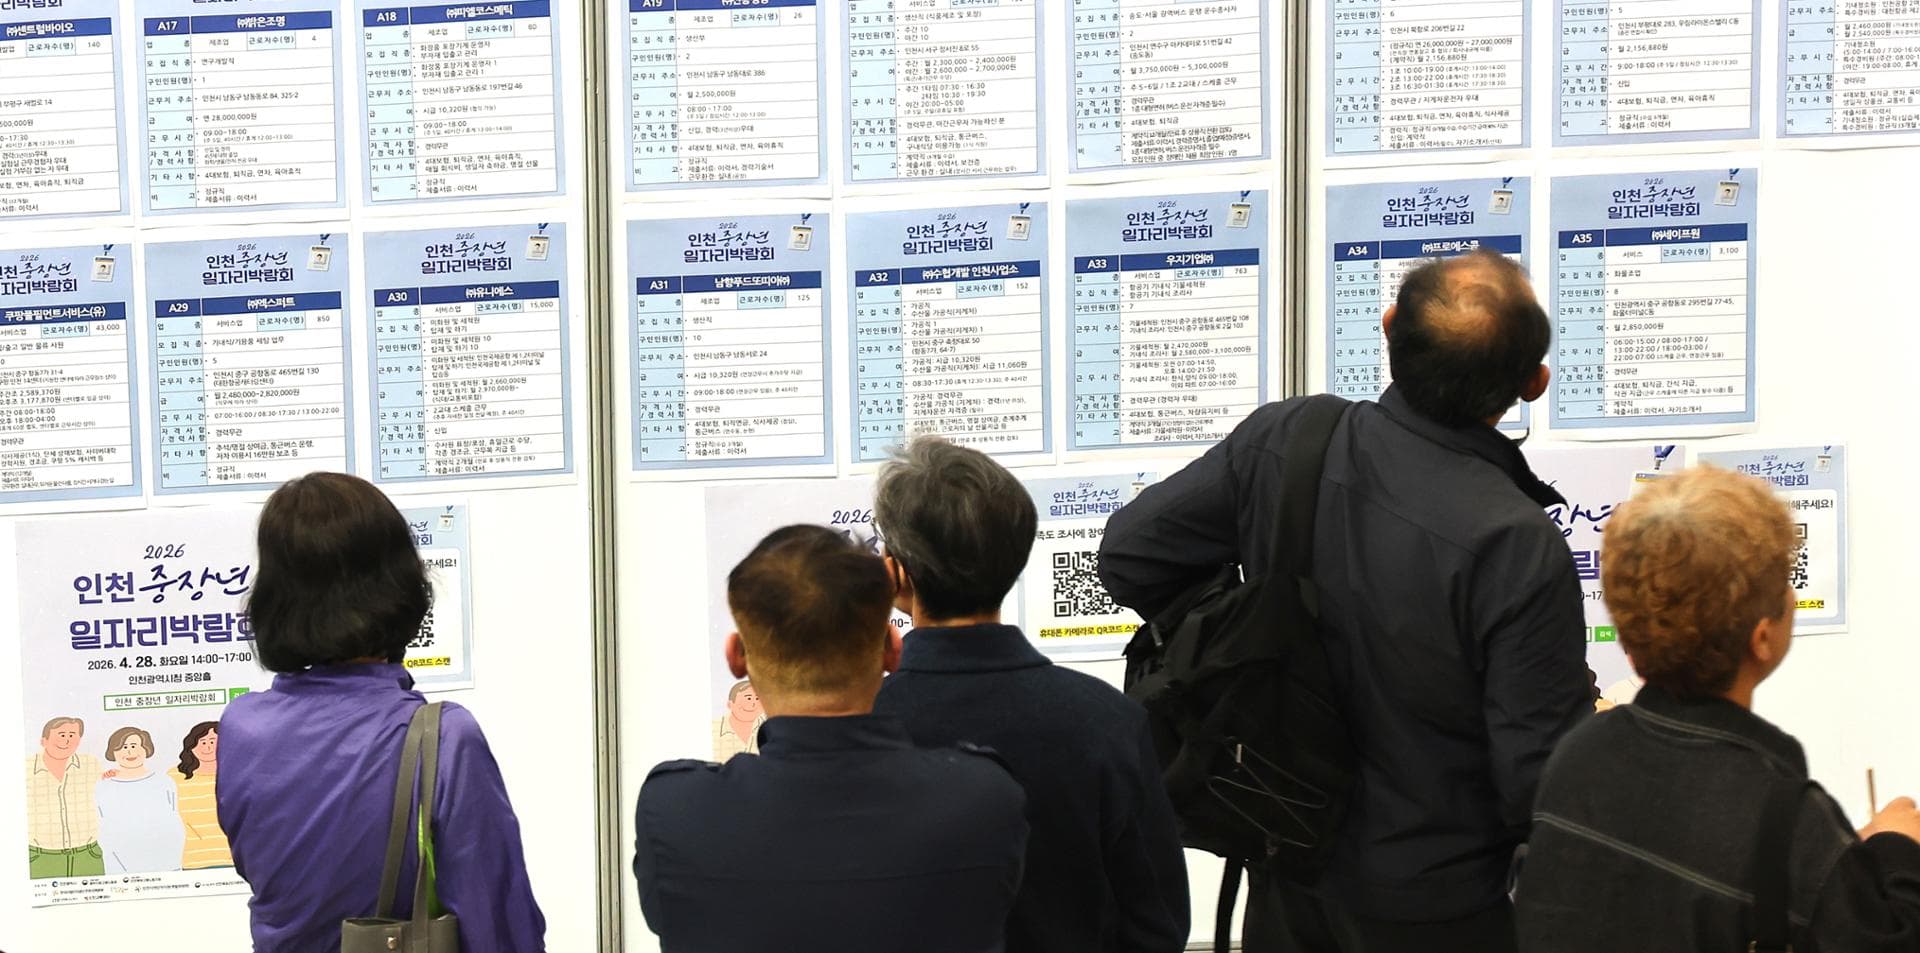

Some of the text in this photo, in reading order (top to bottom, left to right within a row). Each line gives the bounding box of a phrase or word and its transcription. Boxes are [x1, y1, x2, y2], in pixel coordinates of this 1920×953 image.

[377, 12, 396, 22] A18
[733, 13, 778, 22] 근로자수(명)
[158, 21, 177, 30] A17
[468, 25, 512, 34] 근로자수(명)
[249, 34, 295, 44] 근로자수(명)
[1613, 186, 1696, 203] 인천 중장년
[1387, 195, 1470, 212] 인천 중장년
[1608, 202, 1700, 219] 일자리박람회
[937, 213, 956, 221] 2026
[1127, 209, 1208, 226] 인천 중장년
[1383, 211, 1474, 227] 일자리박람회
[907, 221, 988, 239] 인천 중장년
[1122, 224, 1212, 242] 일자리박람회
[688, 230, 769, 247] 인천 중장년
[1572, 234, 1592, 243] A35
[426, 240, 507, 258] 인천 중장년
[903, 237, 992, 255] 일자리박람회
[1348, 246, 1367, 255] A34
[684, 246, 774, 263] 일자리박람회
[1663, 248, 1709, 257] 근로자수(명)
[207, 252, 288, 269] 인천 중장년
[422, 257, 511, 274] 일자리박람회
[1088, 259, 1106, 268] A33
[20, 262, 72, 280] 중장년
[203, 267, 293, 285] 일자리박람회
[972, 265, 1019, 277] 인천사업소
[1176, 268, 1222, 277] 근로자수(명)
[869, 272, 888, 282] A32
[1, 279, 77, 295] 자리박람회
[650, 281, 667, 289] A31
[958, 284, 1003, 294] 근로자수(명)
[388, 292, 407, 301] A30
[740, 296, 784, 304] 근로자수(명)
[169, 303, 188, 312] A29
[477, 303, 522, 311] 근로자수(명)
[259, 317, 304, 325] 근로자수(명)
[42, 326, 88, 334] 근로자수(명)
[1762, 461, 1806, 475] 중장년
[1053, 488, 1120, 503] 인천 중장년
[1790, 499, 1833, 510] 해주세요!
[831, 509, 872, 525] 2026
[1057, 529, 1085, 539] 조사에
[144, 544, 185, 559] 2026
[423, 559, 456, 568] 주세요!
[74, 564, 251, 604] 인천 중장년
[1064, 627, 1094, 636] 카메라로
[1097, 626, 1123, 635] QR코드
[88, 660, 116, 670] 2026.
[119, 658, 131, 668] 4.
[136, 656, 156, 667] 28.
[160, 656, 188, 666] 화요일
[407, 659, 433, 668] QR코드
[114, 693, 216, 707] 인천 중장년 일자리박람회
